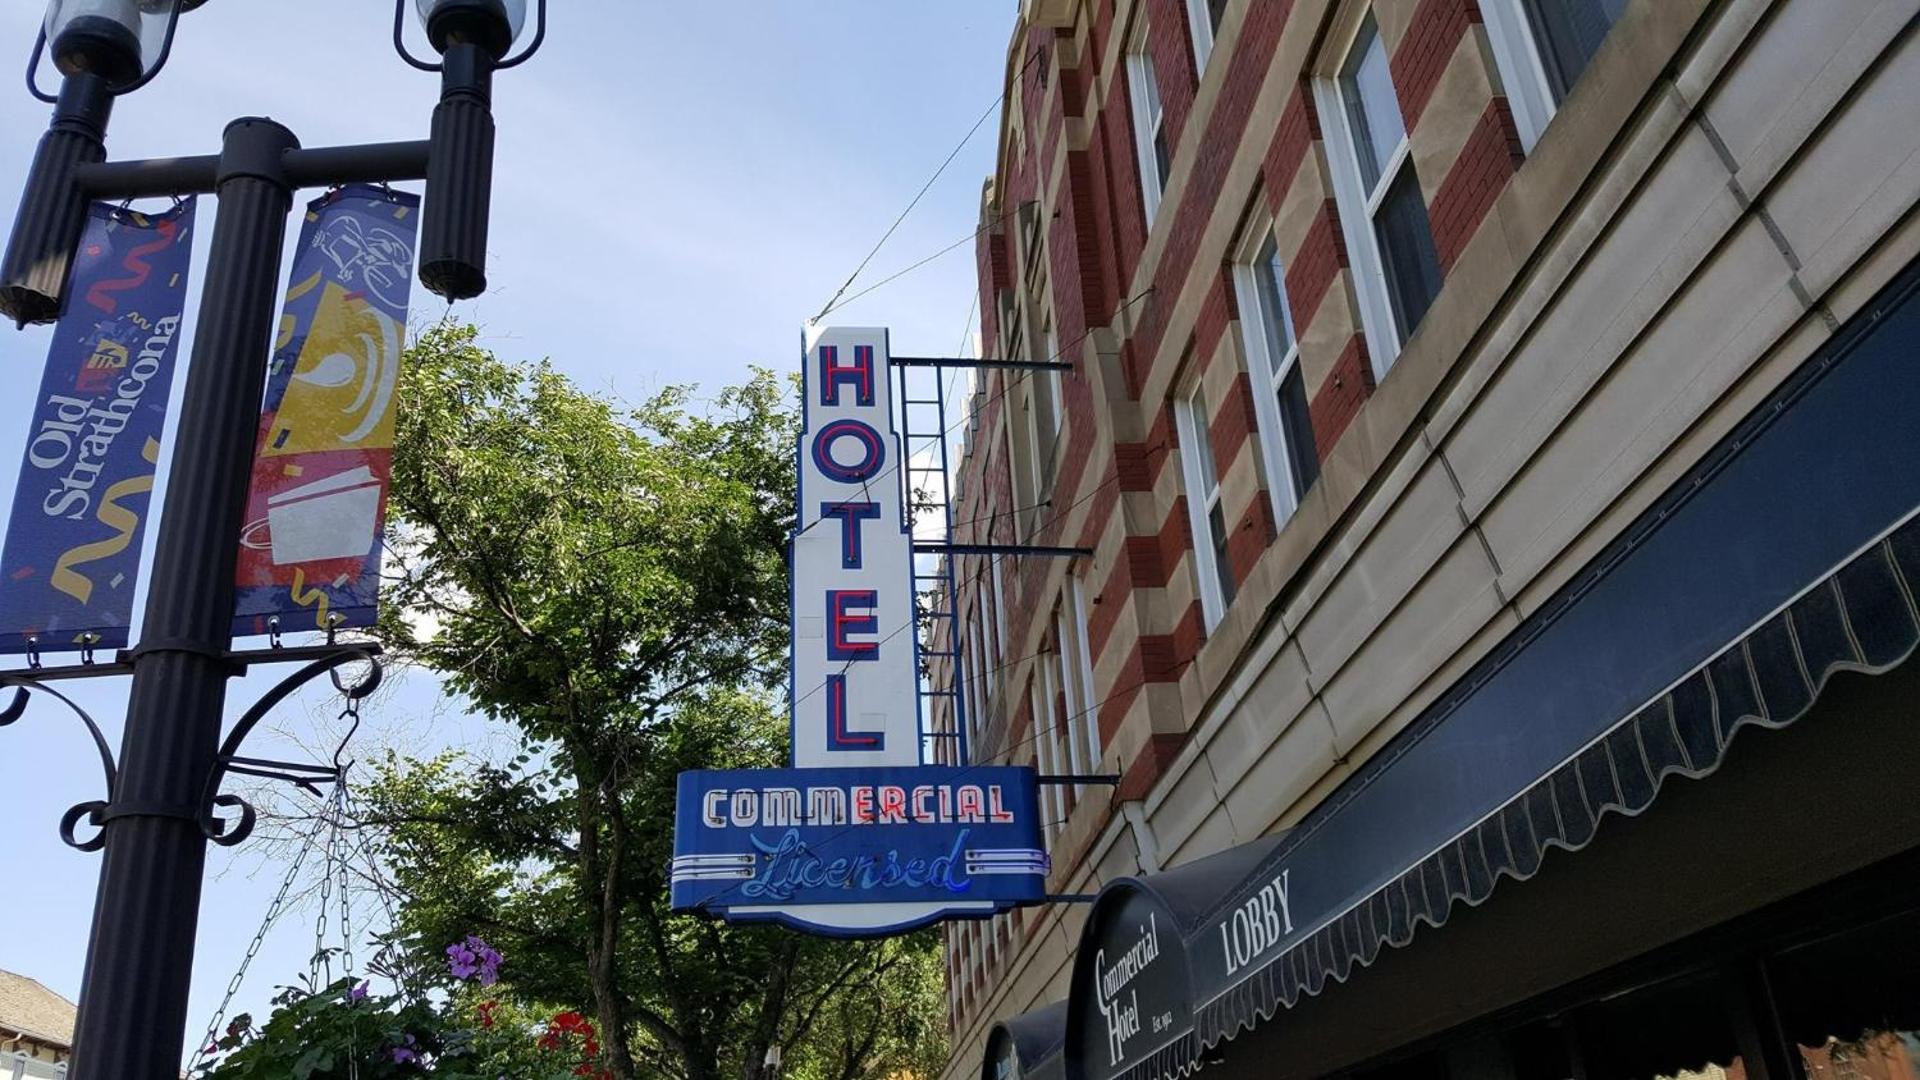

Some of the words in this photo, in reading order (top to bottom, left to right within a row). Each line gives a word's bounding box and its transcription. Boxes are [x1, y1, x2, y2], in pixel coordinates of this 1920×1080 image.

[30, 394, 94, 470] Old
[44, 311, 181, 521] Strathcona
[811, 345, 886, 752] HOTEL
[702, 784, 1015, 829] COMMERCIAL
[741, 827, 971, 900] Licensed
[1095, 911, 1160, 1017] Commercial
[1219, 868, 1295, 977] LOBBY
[1105, 989, 1141, 1067] Hotel
